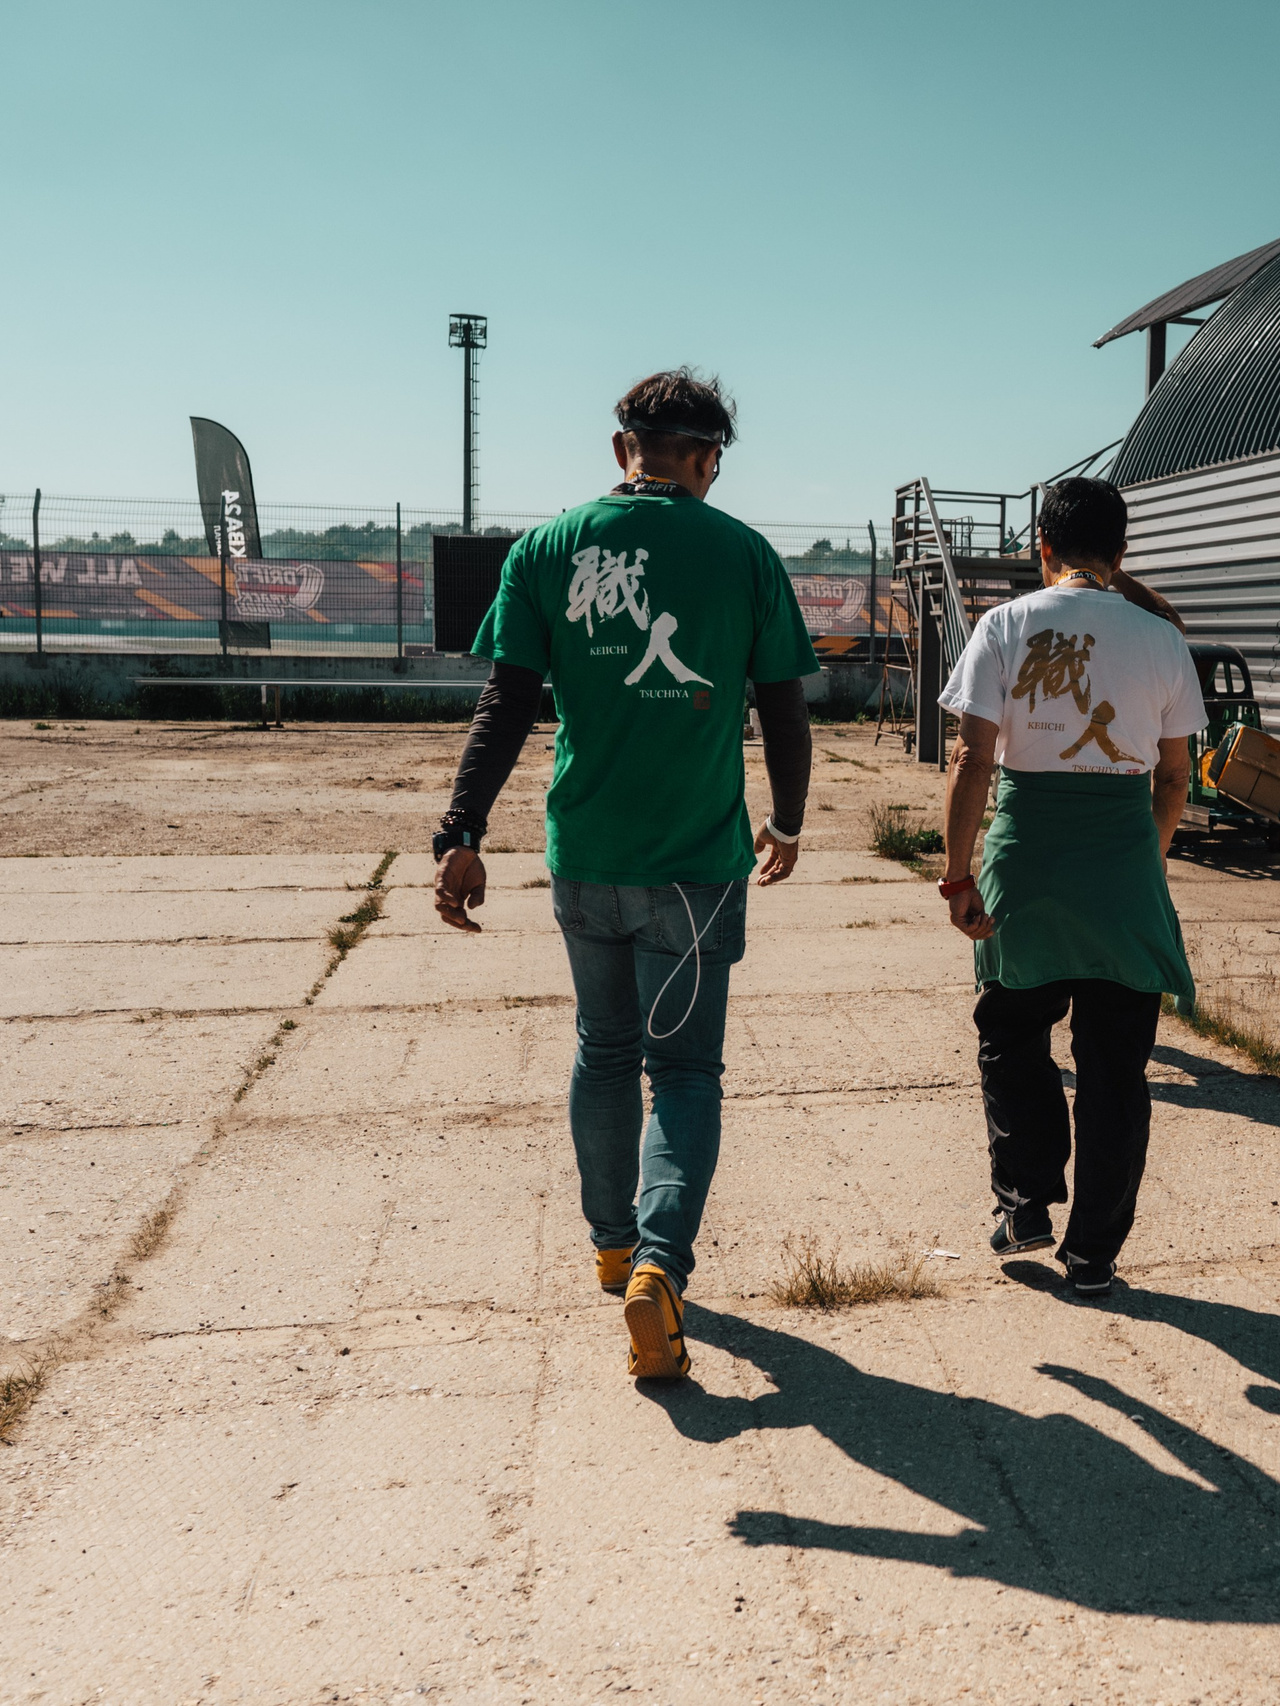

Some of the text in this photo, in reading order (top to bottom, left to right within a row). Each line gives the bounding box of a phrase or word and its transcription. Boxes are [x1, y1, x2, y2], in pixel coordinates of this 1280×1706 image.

[590, 645, 628, 656] KEIICHI
[639, 689, 689, 699] TSUCHIYA
[1027, 721, 1065, 732] KEIICHI
[1072, 764, 1120, 775] TSUCHIYA
